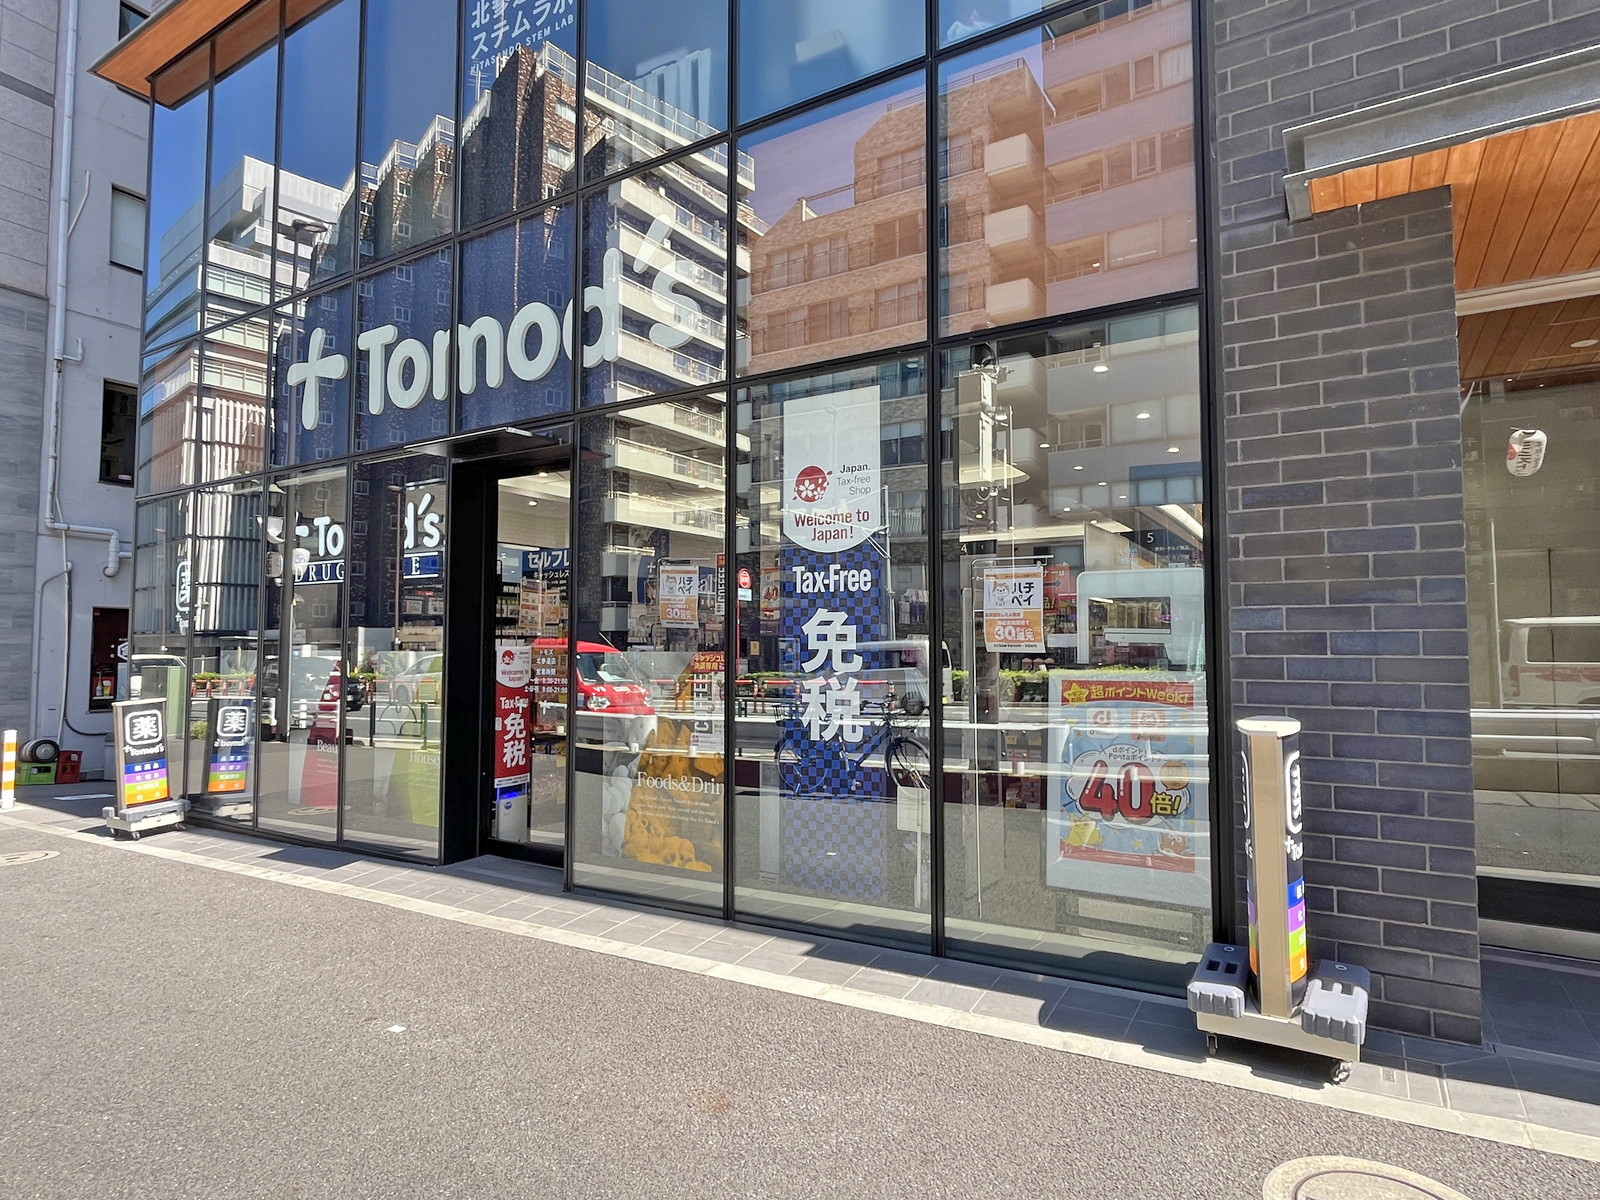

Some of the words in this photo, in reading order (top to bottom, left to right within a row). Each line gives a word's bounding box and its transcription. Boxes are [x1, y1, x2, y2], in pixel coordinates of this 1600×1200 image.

[471, 0, 528, 28] 北参
[525, 26, 550, 46] STEM
[555, 14, 574, 31] LAB
[840, 464, 871, 474] Japan.
[837, 475, 871, 486] Tax-free
[849, 486, 871, 496] Shop
[794, 511, 853, 527] Welcome
[856, 509, 870, 522] to
[811, 526, 854, 543] Japan!
[1146, 532, 1154, 543] 5
[960, 544, 968, 553] 4
[294, 562, 345, 582] DRUG
[792, 564, 872, 594] Tax-Free
[1012, 582, 1035, 594] ハチ
[1012, 594, 1034, 606] ペイ
[801, 608, 864, 743] 免税
[132, 715, 158, 739] 薬
[317, 740, 338, 753] Beau
[503, 712, 527, 768] 免税
[637, 771, 724, 795] Foods&Drin
